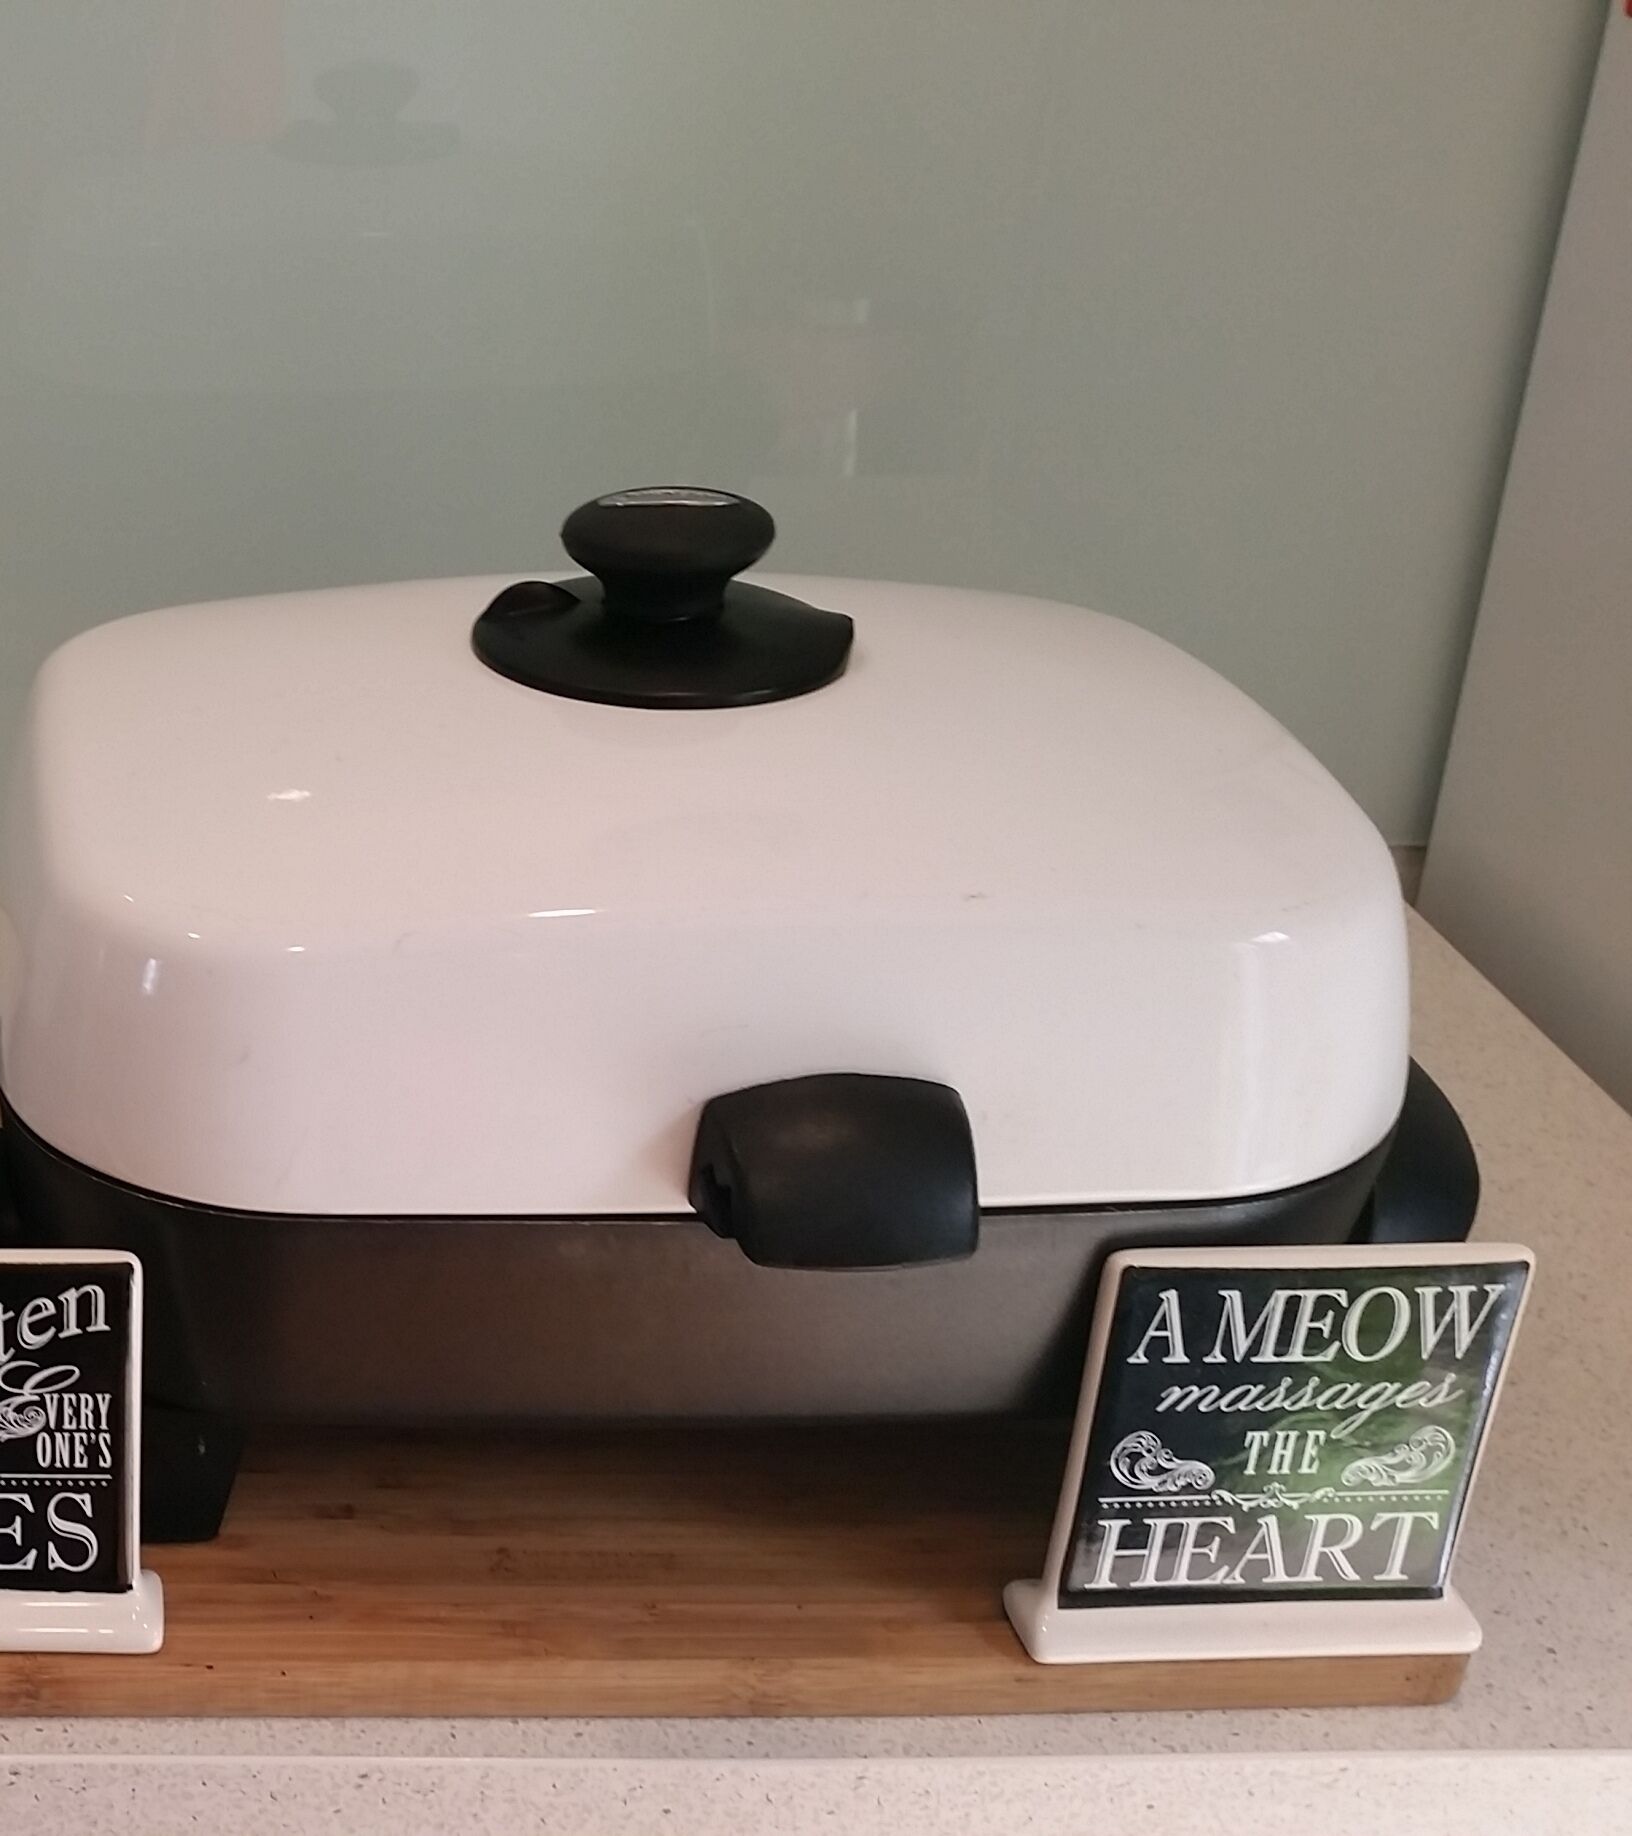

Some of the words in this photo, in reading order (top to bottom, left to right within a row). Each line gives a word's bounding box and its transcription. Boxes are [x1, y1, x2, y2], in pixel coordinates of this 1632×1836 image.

[1126, 1288, 1191, 1365] A
[1202, 1284, 1506, 1364] MEOW
[1155, 1372, 1465, 1440] massages
[36, 1433, 113, 1470] ONE'S
[1243, 1429, 1329, 1475] THE
[1083, 1511, 1441, 1590] HEART
